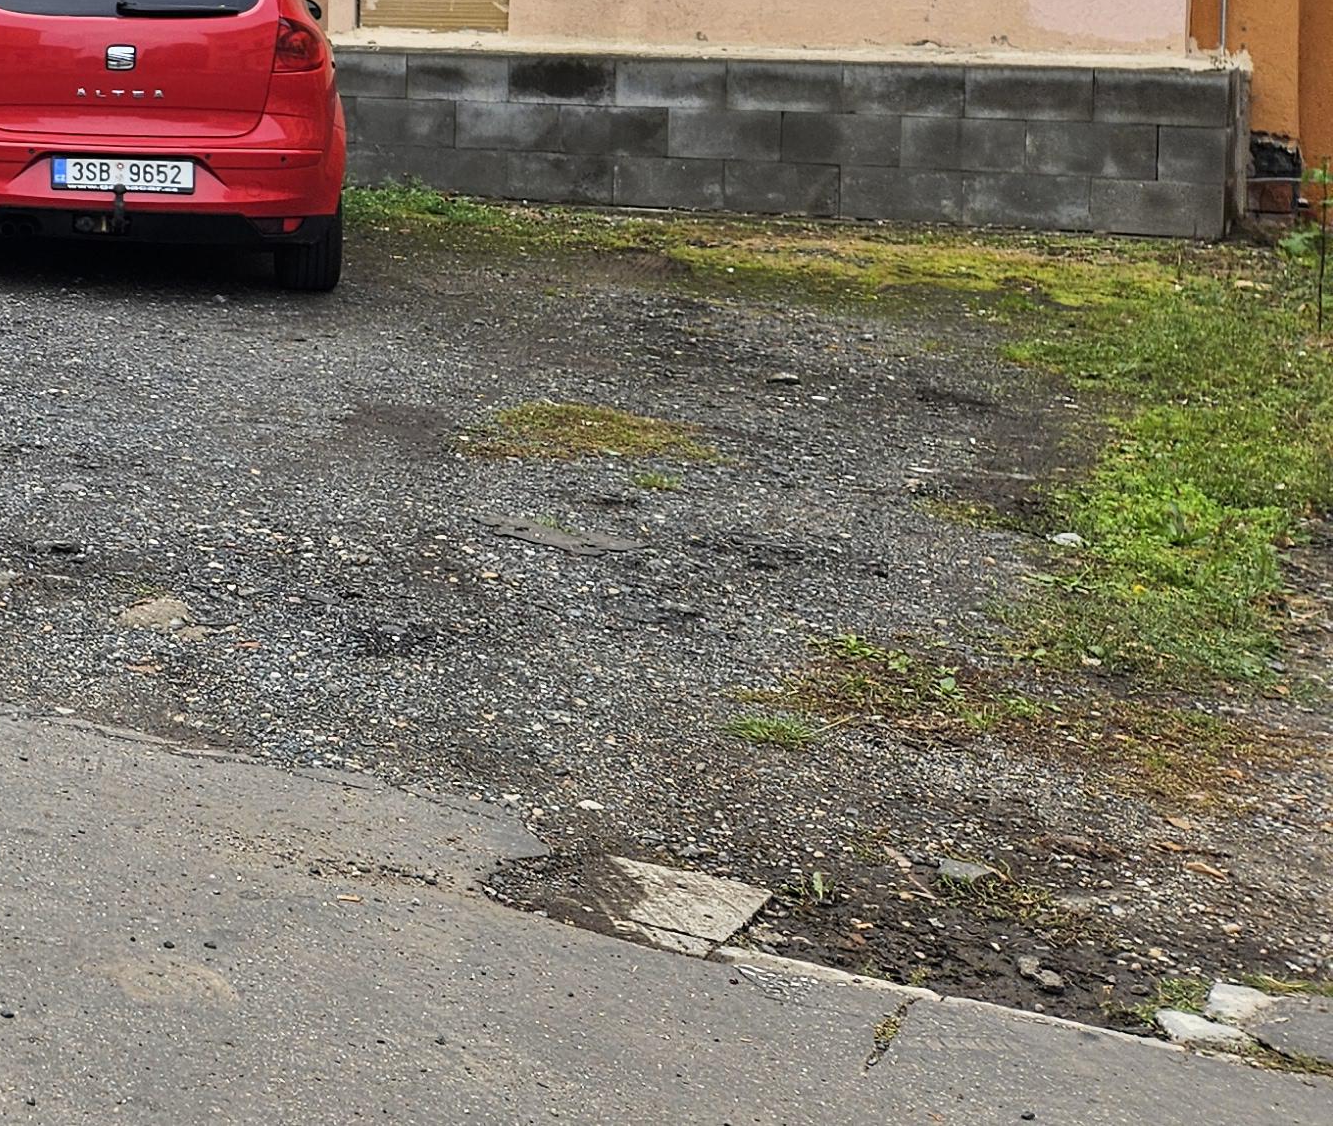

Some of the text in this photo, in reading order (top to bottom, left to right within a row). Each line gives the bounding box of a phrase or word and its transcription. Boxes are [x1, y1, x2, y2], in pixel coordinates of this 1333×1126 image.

[76, 87, 164, 98] ALTEA
[72, 161, 182, 185] 3SB 9652
